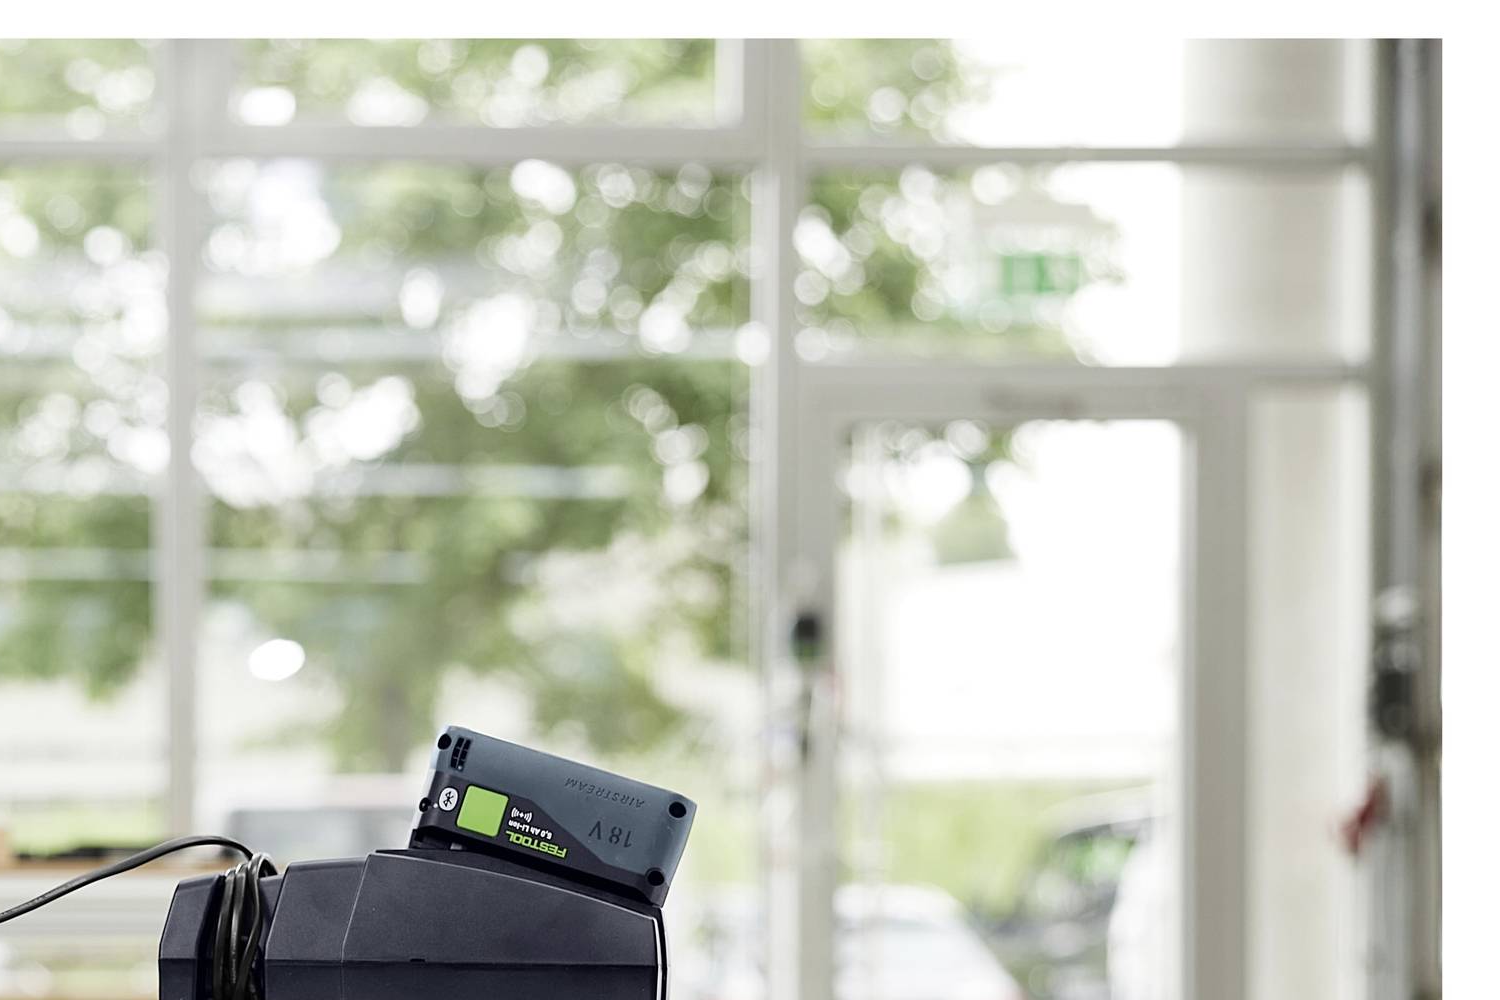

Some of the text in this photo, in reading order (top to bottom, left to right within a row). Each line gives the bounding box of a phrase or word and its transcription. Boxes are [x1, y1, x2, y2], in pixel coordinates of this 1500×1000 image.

[564, 777, 645, 809] AIRSTREAM
[505, 830, 568, 859] FESTOOL
[530, 825, 541, 837] Ah
